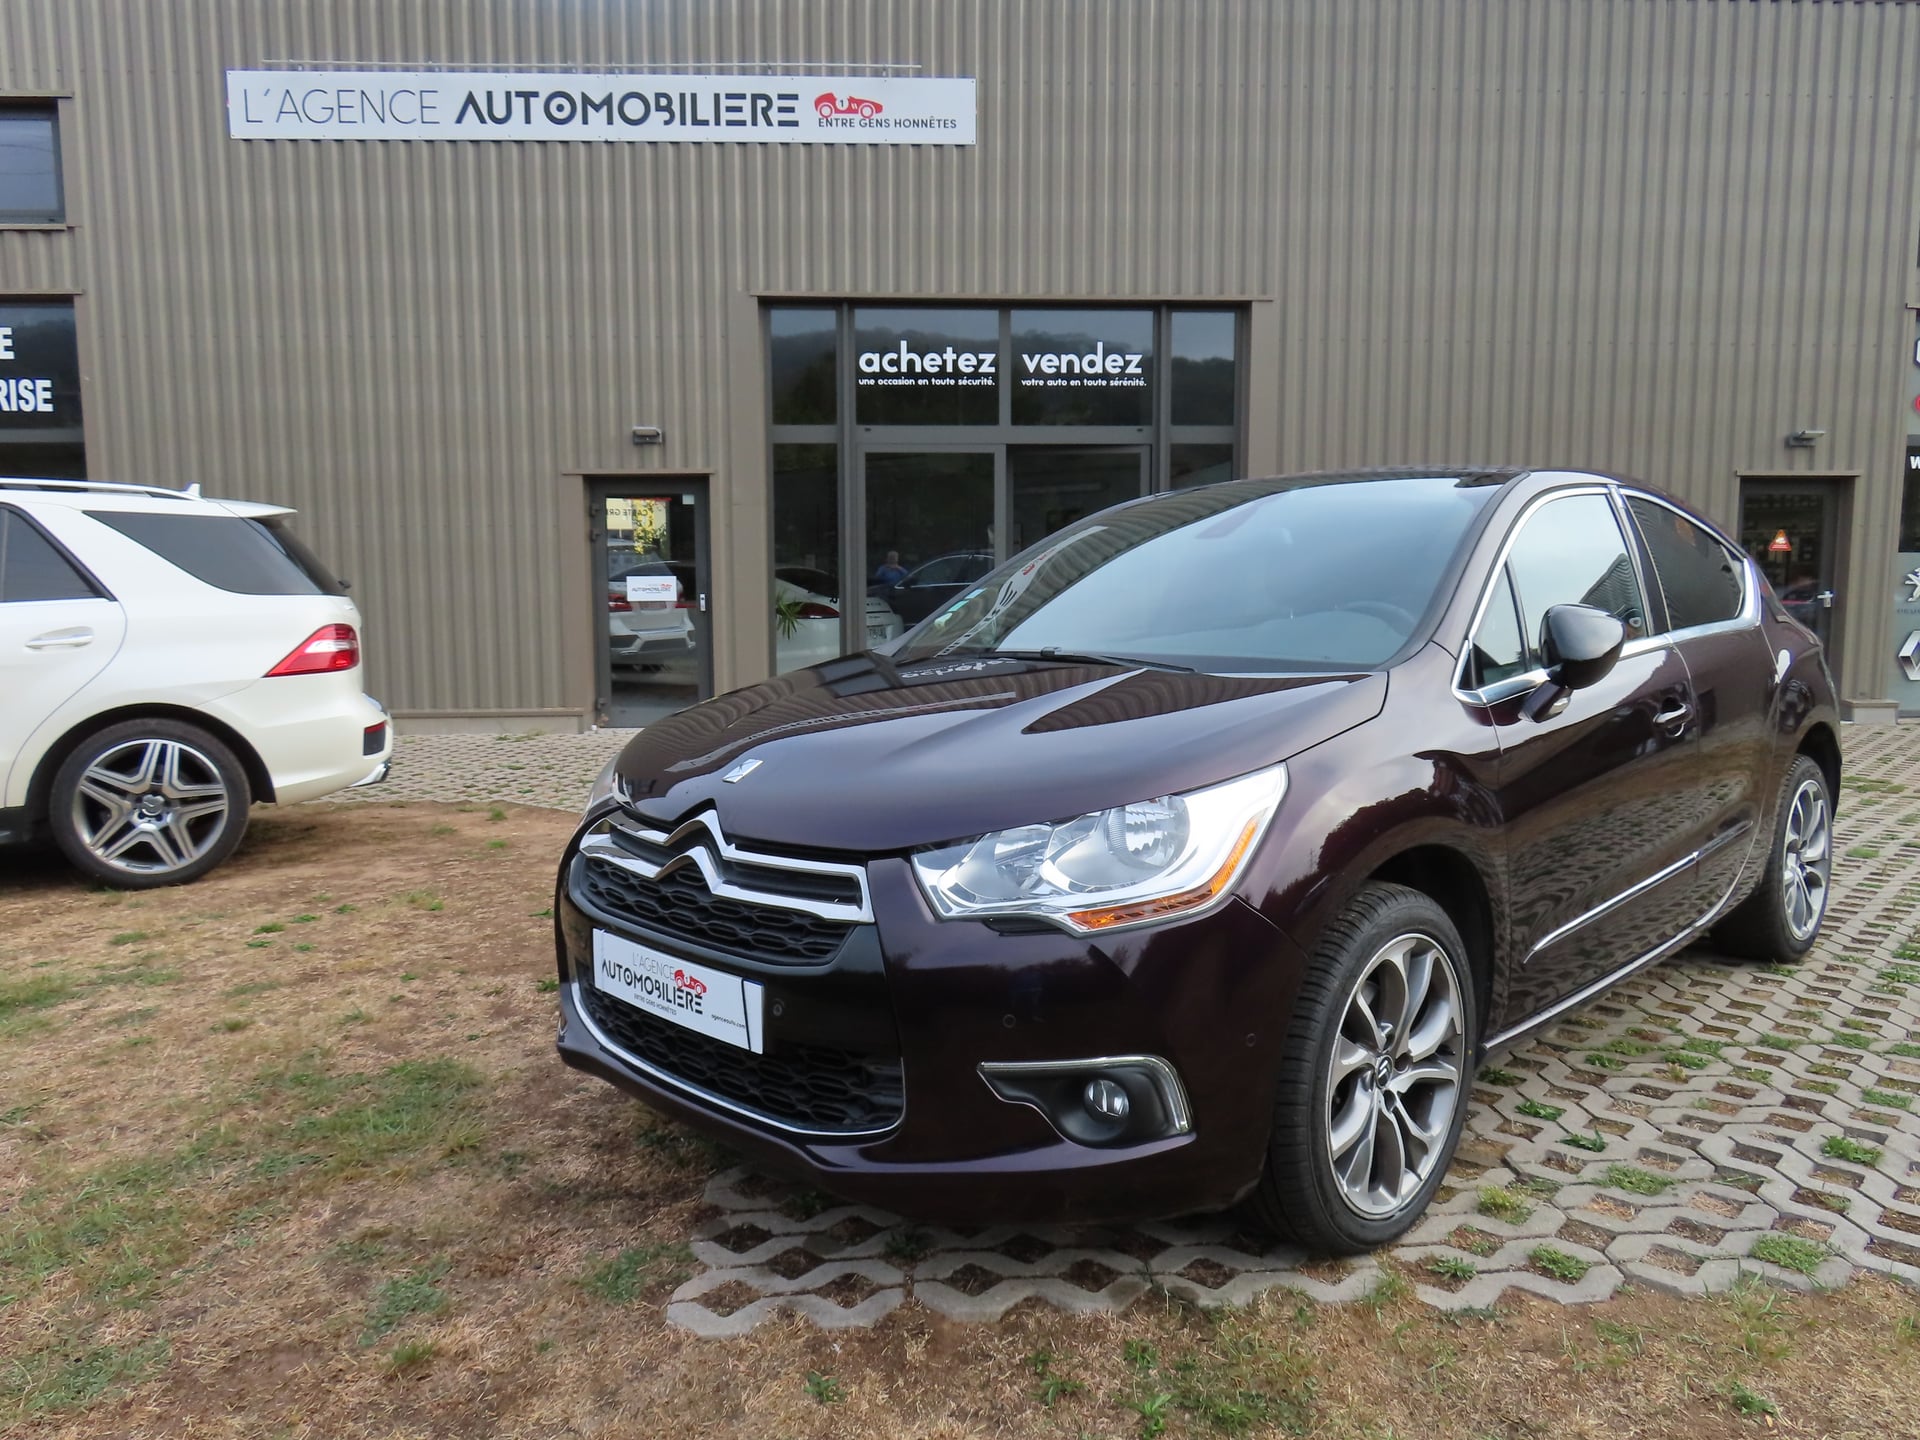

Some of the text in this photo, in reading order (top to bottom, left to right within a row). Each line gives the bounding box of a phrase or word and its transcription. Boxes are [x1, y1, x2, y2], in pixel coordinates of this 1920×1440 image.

[243, 88, 800, 128] L'AGENCE AUTOMOBILIERE
[818, 115, 957, 129] ENTRE GENS HONNÊTES
[858, 340, 997, 374] achetez
[1021, 341, 1143, 374] vendez
[858, 376, 996, 386] une occasion en toute sécurité.
[1021, 377, 1147, 387] votre auto en toute sérénité.
[632, 952, 675, 981] L'AGENCE
[601, 958, 703, 1015] AUTOMOBILIERE
